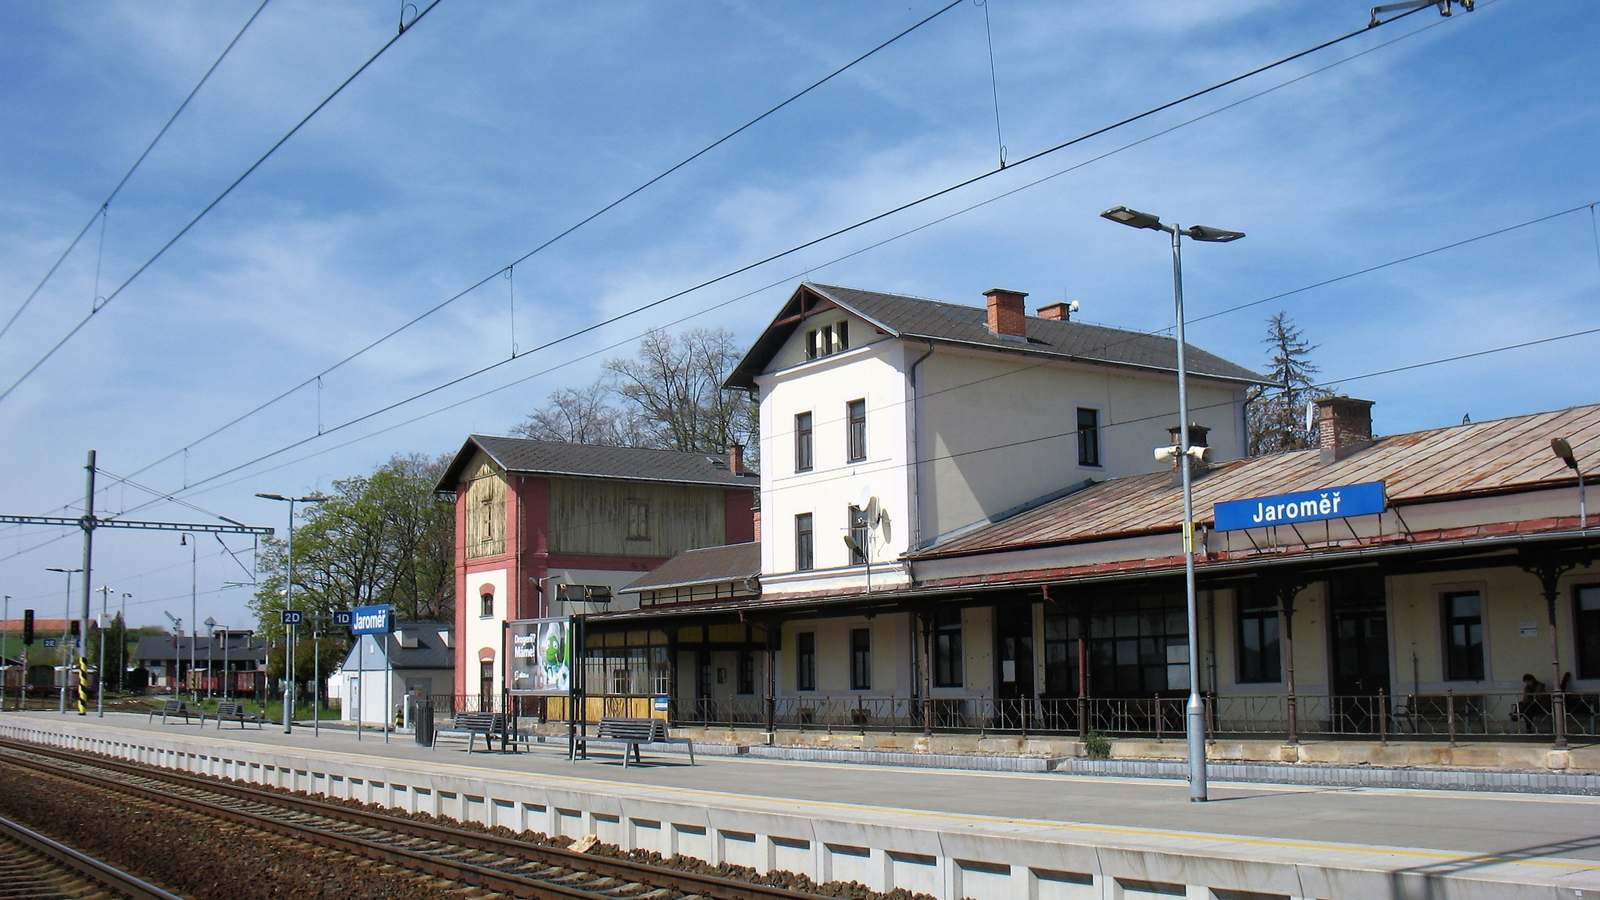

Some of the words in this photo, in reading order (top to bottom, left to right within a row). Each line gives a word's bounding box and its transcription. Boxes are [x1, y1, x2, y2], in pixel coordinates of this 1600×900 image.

[1253, 491, 1341, 523] Jaroměř
[285, 613, 300, 622] 2D
[336, 614, 349, 623] 1D
[354, 609, 386, 630] Jaroměř
